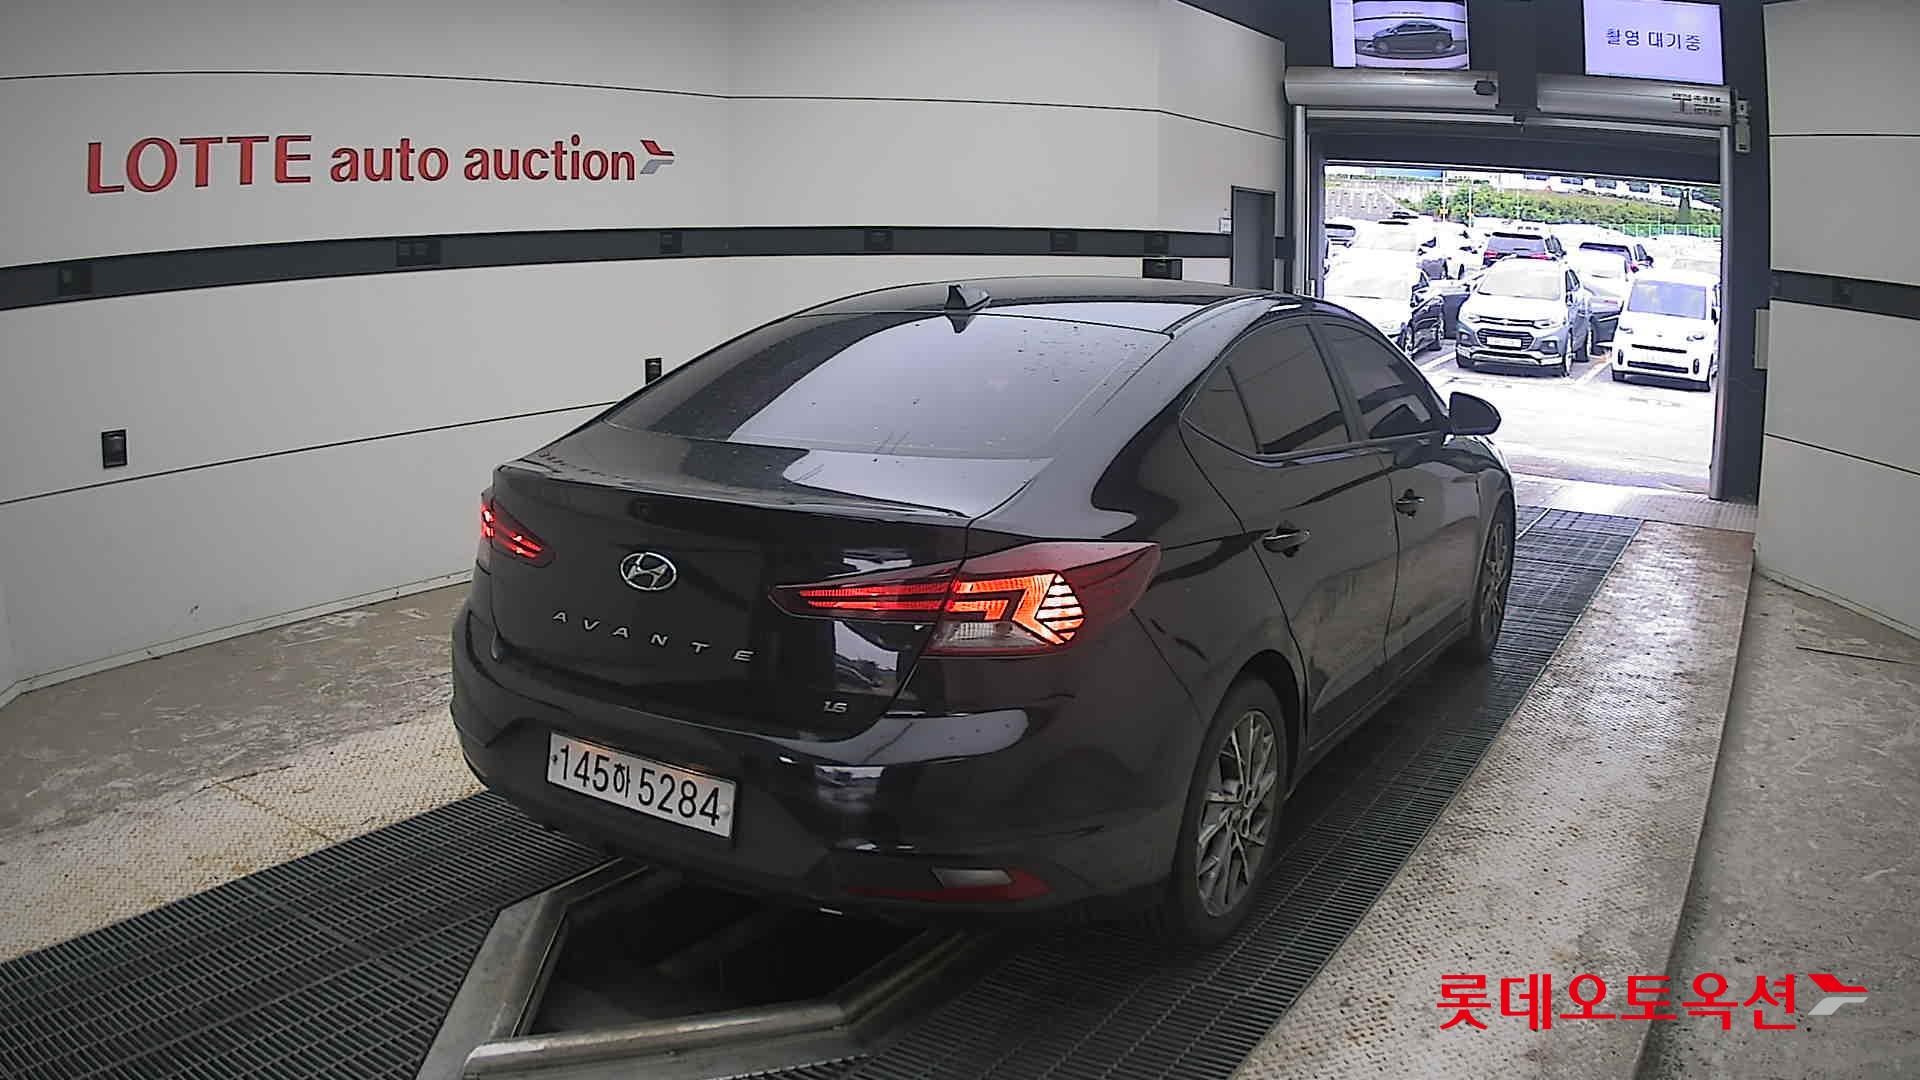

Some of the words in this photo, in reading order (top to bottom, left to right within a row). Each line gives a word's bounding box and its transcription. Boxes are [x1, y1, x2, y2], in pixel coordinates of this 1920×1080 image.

[1606, 28, 1640, 47] 촬영
[86, 134, 312, 194] LOTTE
[329, 137, 449, 182] auto
[463, 134, 636, 182] auction
[552, 611, 755, 662] AVANTE
